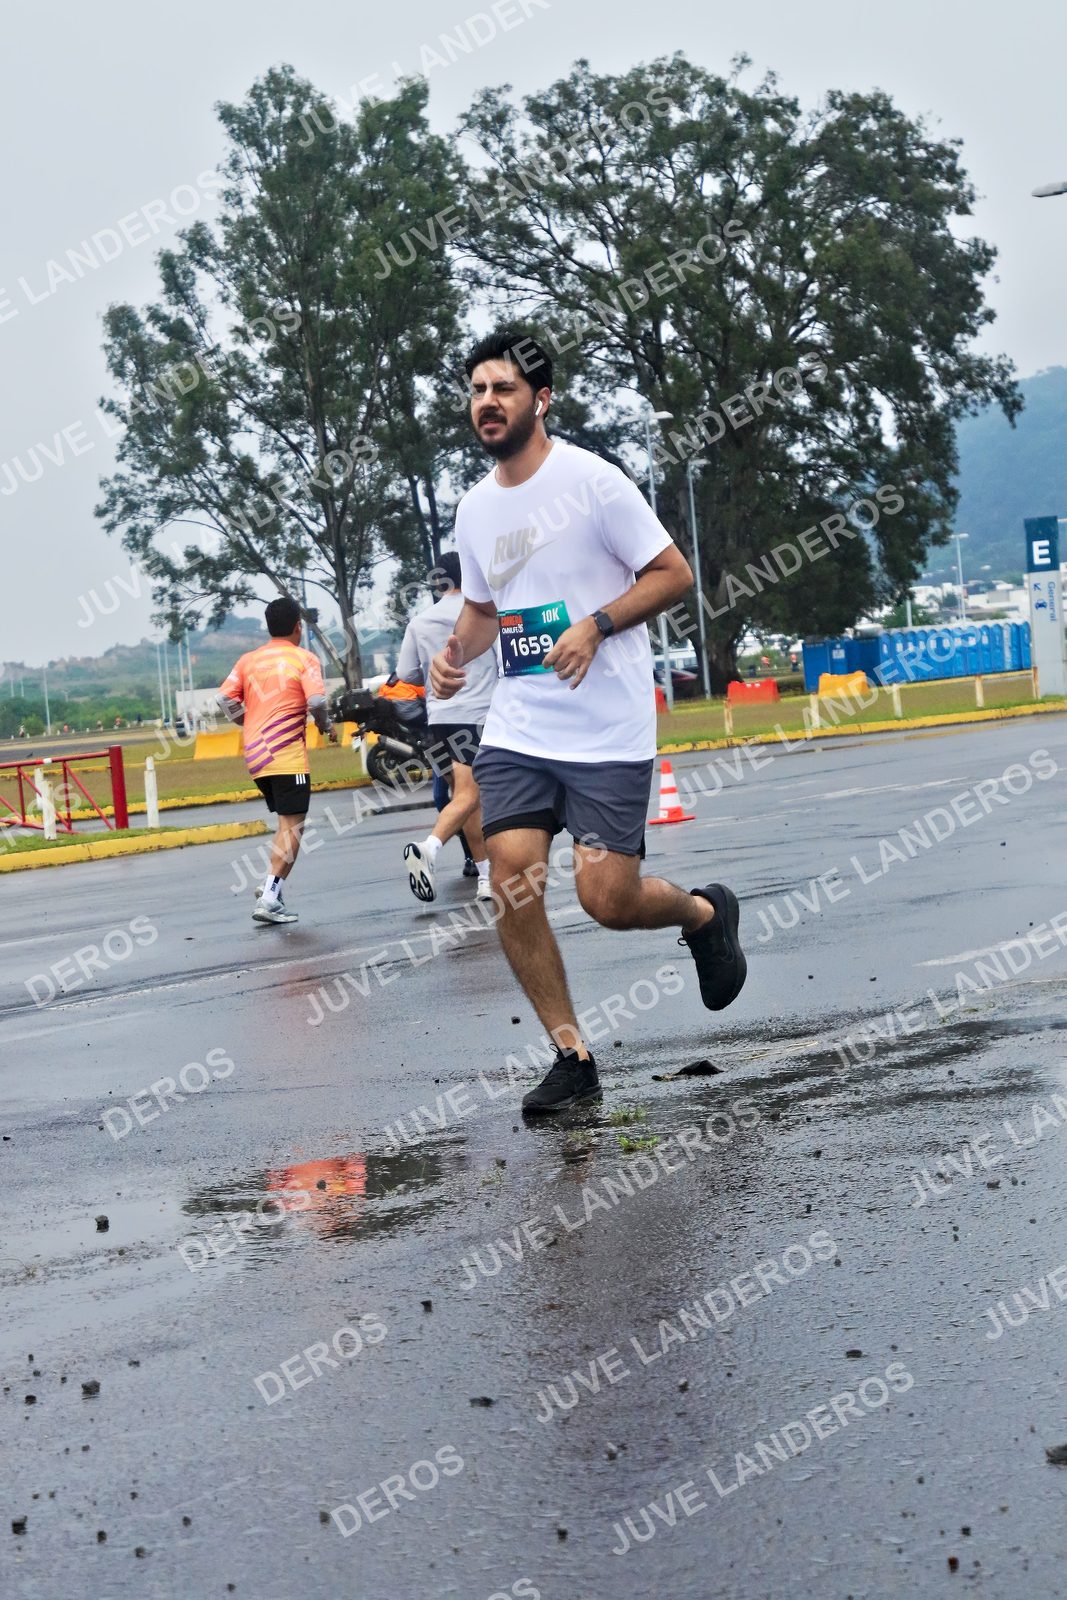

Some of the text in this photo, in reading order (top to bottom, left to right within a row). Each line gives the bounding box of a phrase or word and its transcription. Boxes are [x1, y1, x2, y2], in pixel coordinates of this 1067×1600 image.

[1032, 540, 1051, 565] E
[541, 607, 560, 624] 10K
[510, 634, 554, 657] 1659
